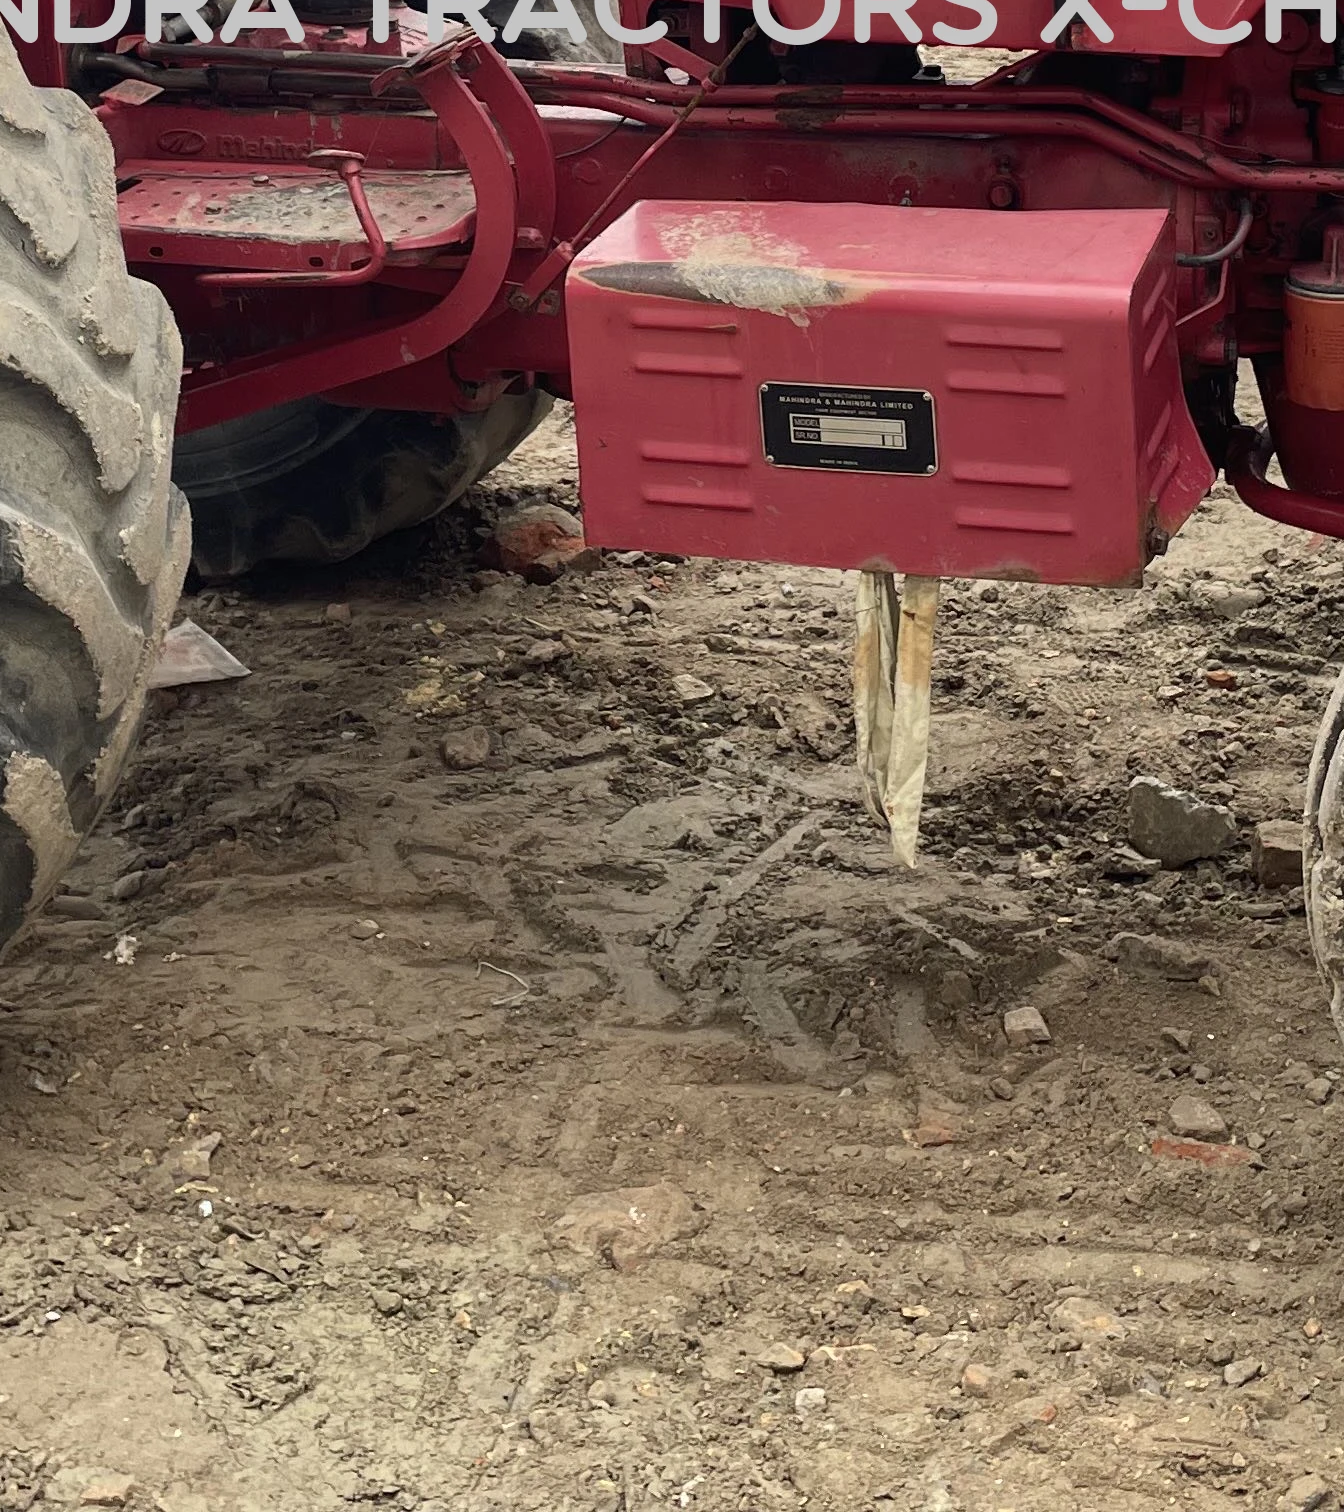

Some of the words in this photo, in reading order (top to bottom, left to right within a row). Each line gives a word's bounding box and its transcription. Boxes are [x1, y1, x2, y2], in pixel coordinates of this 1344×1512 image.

[779, 395, 822, 405] MAHINDRA
[833, 399, 877, 408] MAHINDRA
[879, 401, 914, 410] LIMITED
